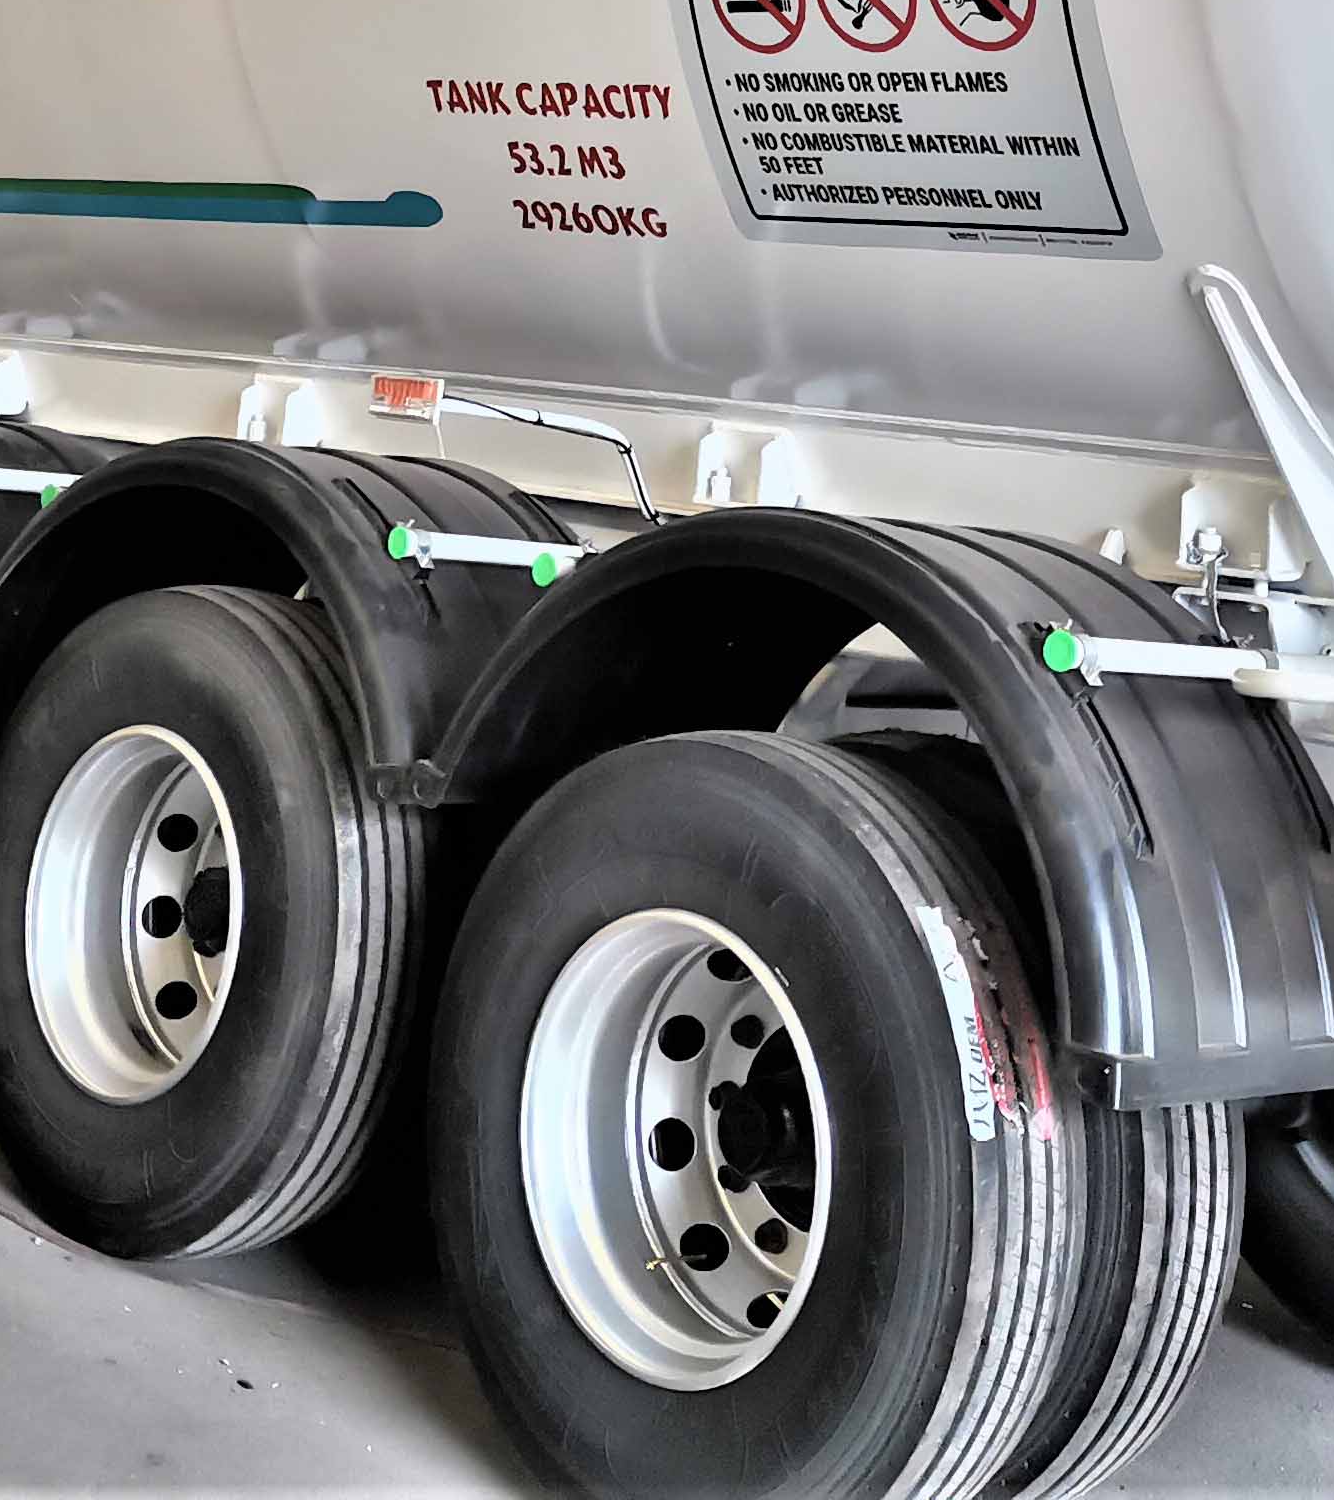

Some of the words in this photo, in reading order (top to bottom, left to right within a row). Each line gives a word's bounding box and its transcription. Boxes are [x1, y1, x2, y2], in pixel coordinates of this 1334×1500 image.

[734, 73, 760, 92] NO
[763, 72, 845, 92] SMOKING
[847, 72, 874, 92] OR
[877, 72, 928, 92] OPEN
[930, 72, 1008, 92] FLAMES
[427, 79, 511, 116] TANK
[515, 82, 670, 119] CAPACITY
[743, 102, 768, 122] NO
[772, 103, 802, 122] OIL
[803, 103, 830, 122] OR
[831, 103, 903, 123] GREASE
[751, 132, 778, 151] NO
[780, 132, 906, 152] COMBUSTIBLE
[907, 134, 1004, 155] MATERIAL
[1006, 135, 1080, 156] WITHIN
[507, 141, 572, 177] 53.2
[577, 145, 626, 180] M3
[759, 156, 781, 174] 50
[783, 157, 824, 175] FEET
[772, 183, 879, 204] AUTHORIZED
[881, 186, 993, 209] PERSONNEL
[994, 190, 1042, 210] ONLY
